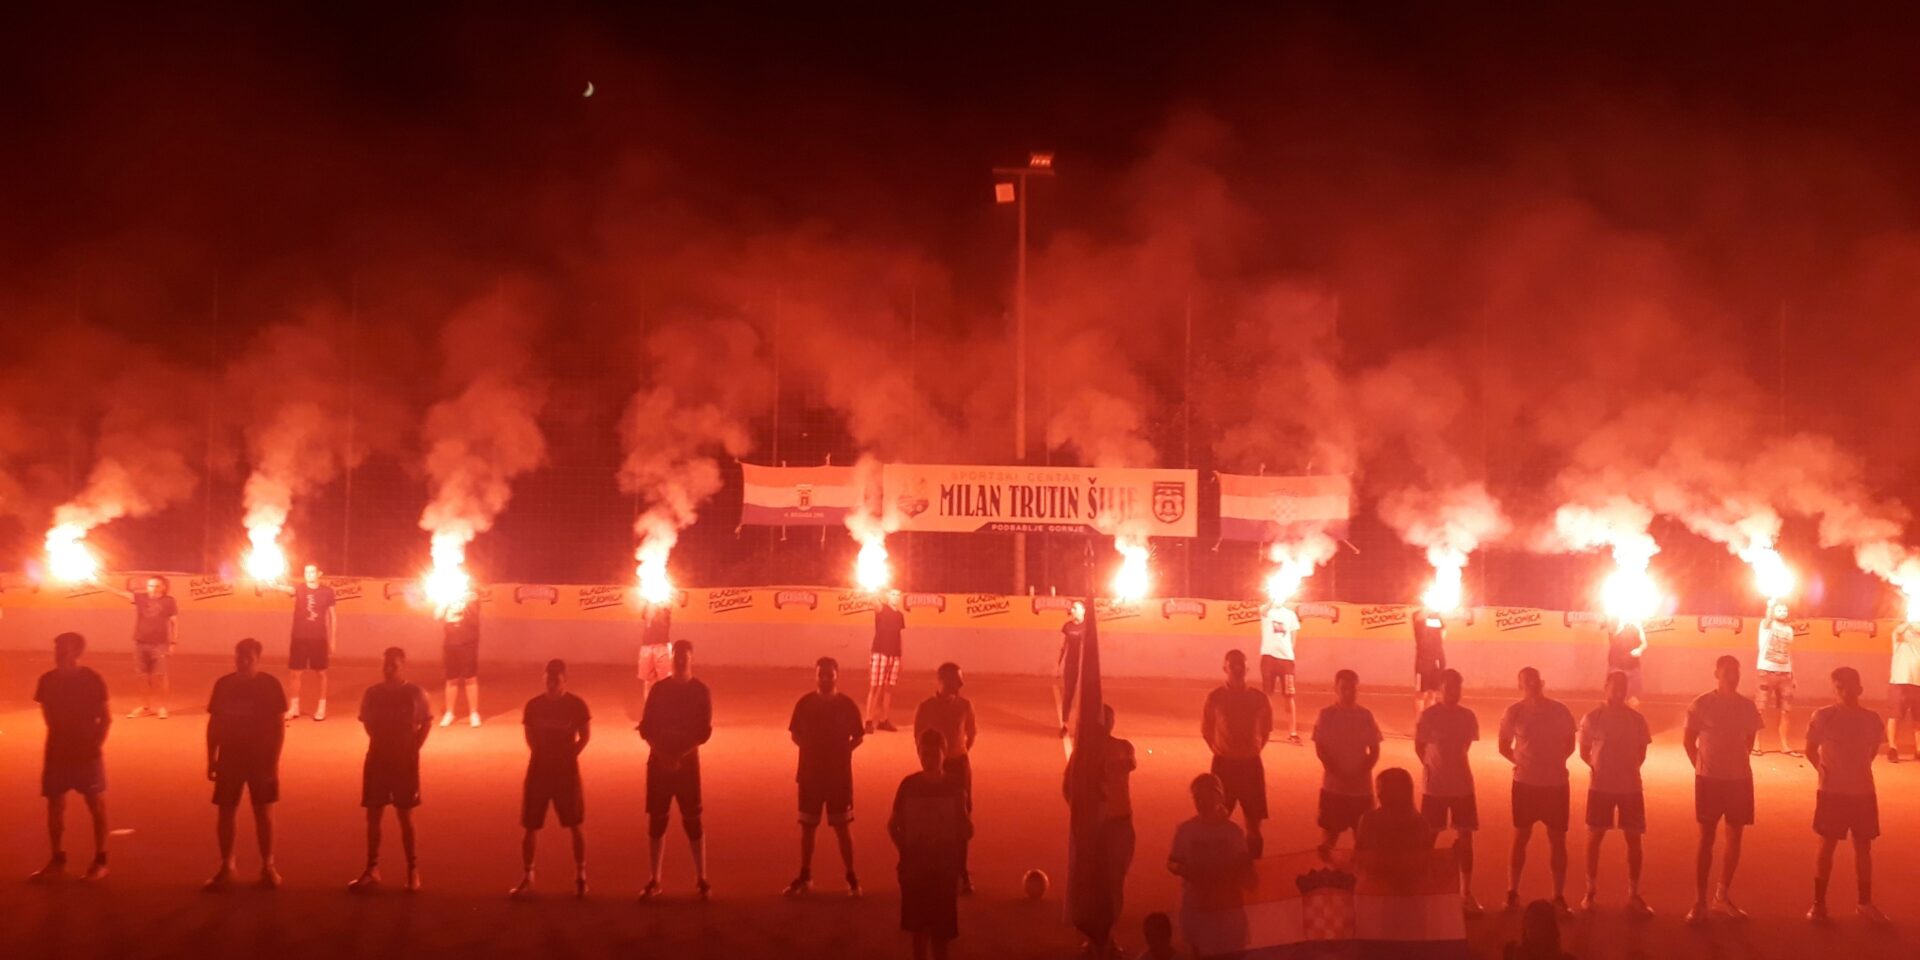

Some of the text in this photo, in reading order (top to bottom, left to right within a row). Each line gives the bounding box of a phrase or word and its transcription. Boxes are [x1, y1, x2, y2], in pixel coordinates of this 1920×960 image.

[950, 470, 1081, 483] SPORTSKI CENTAR
[939, 483, 1001, 517] MILAN
[1008, 485, 1079, 519] TRUTIN
[1048, 525, 1085, 534] GORNJE
